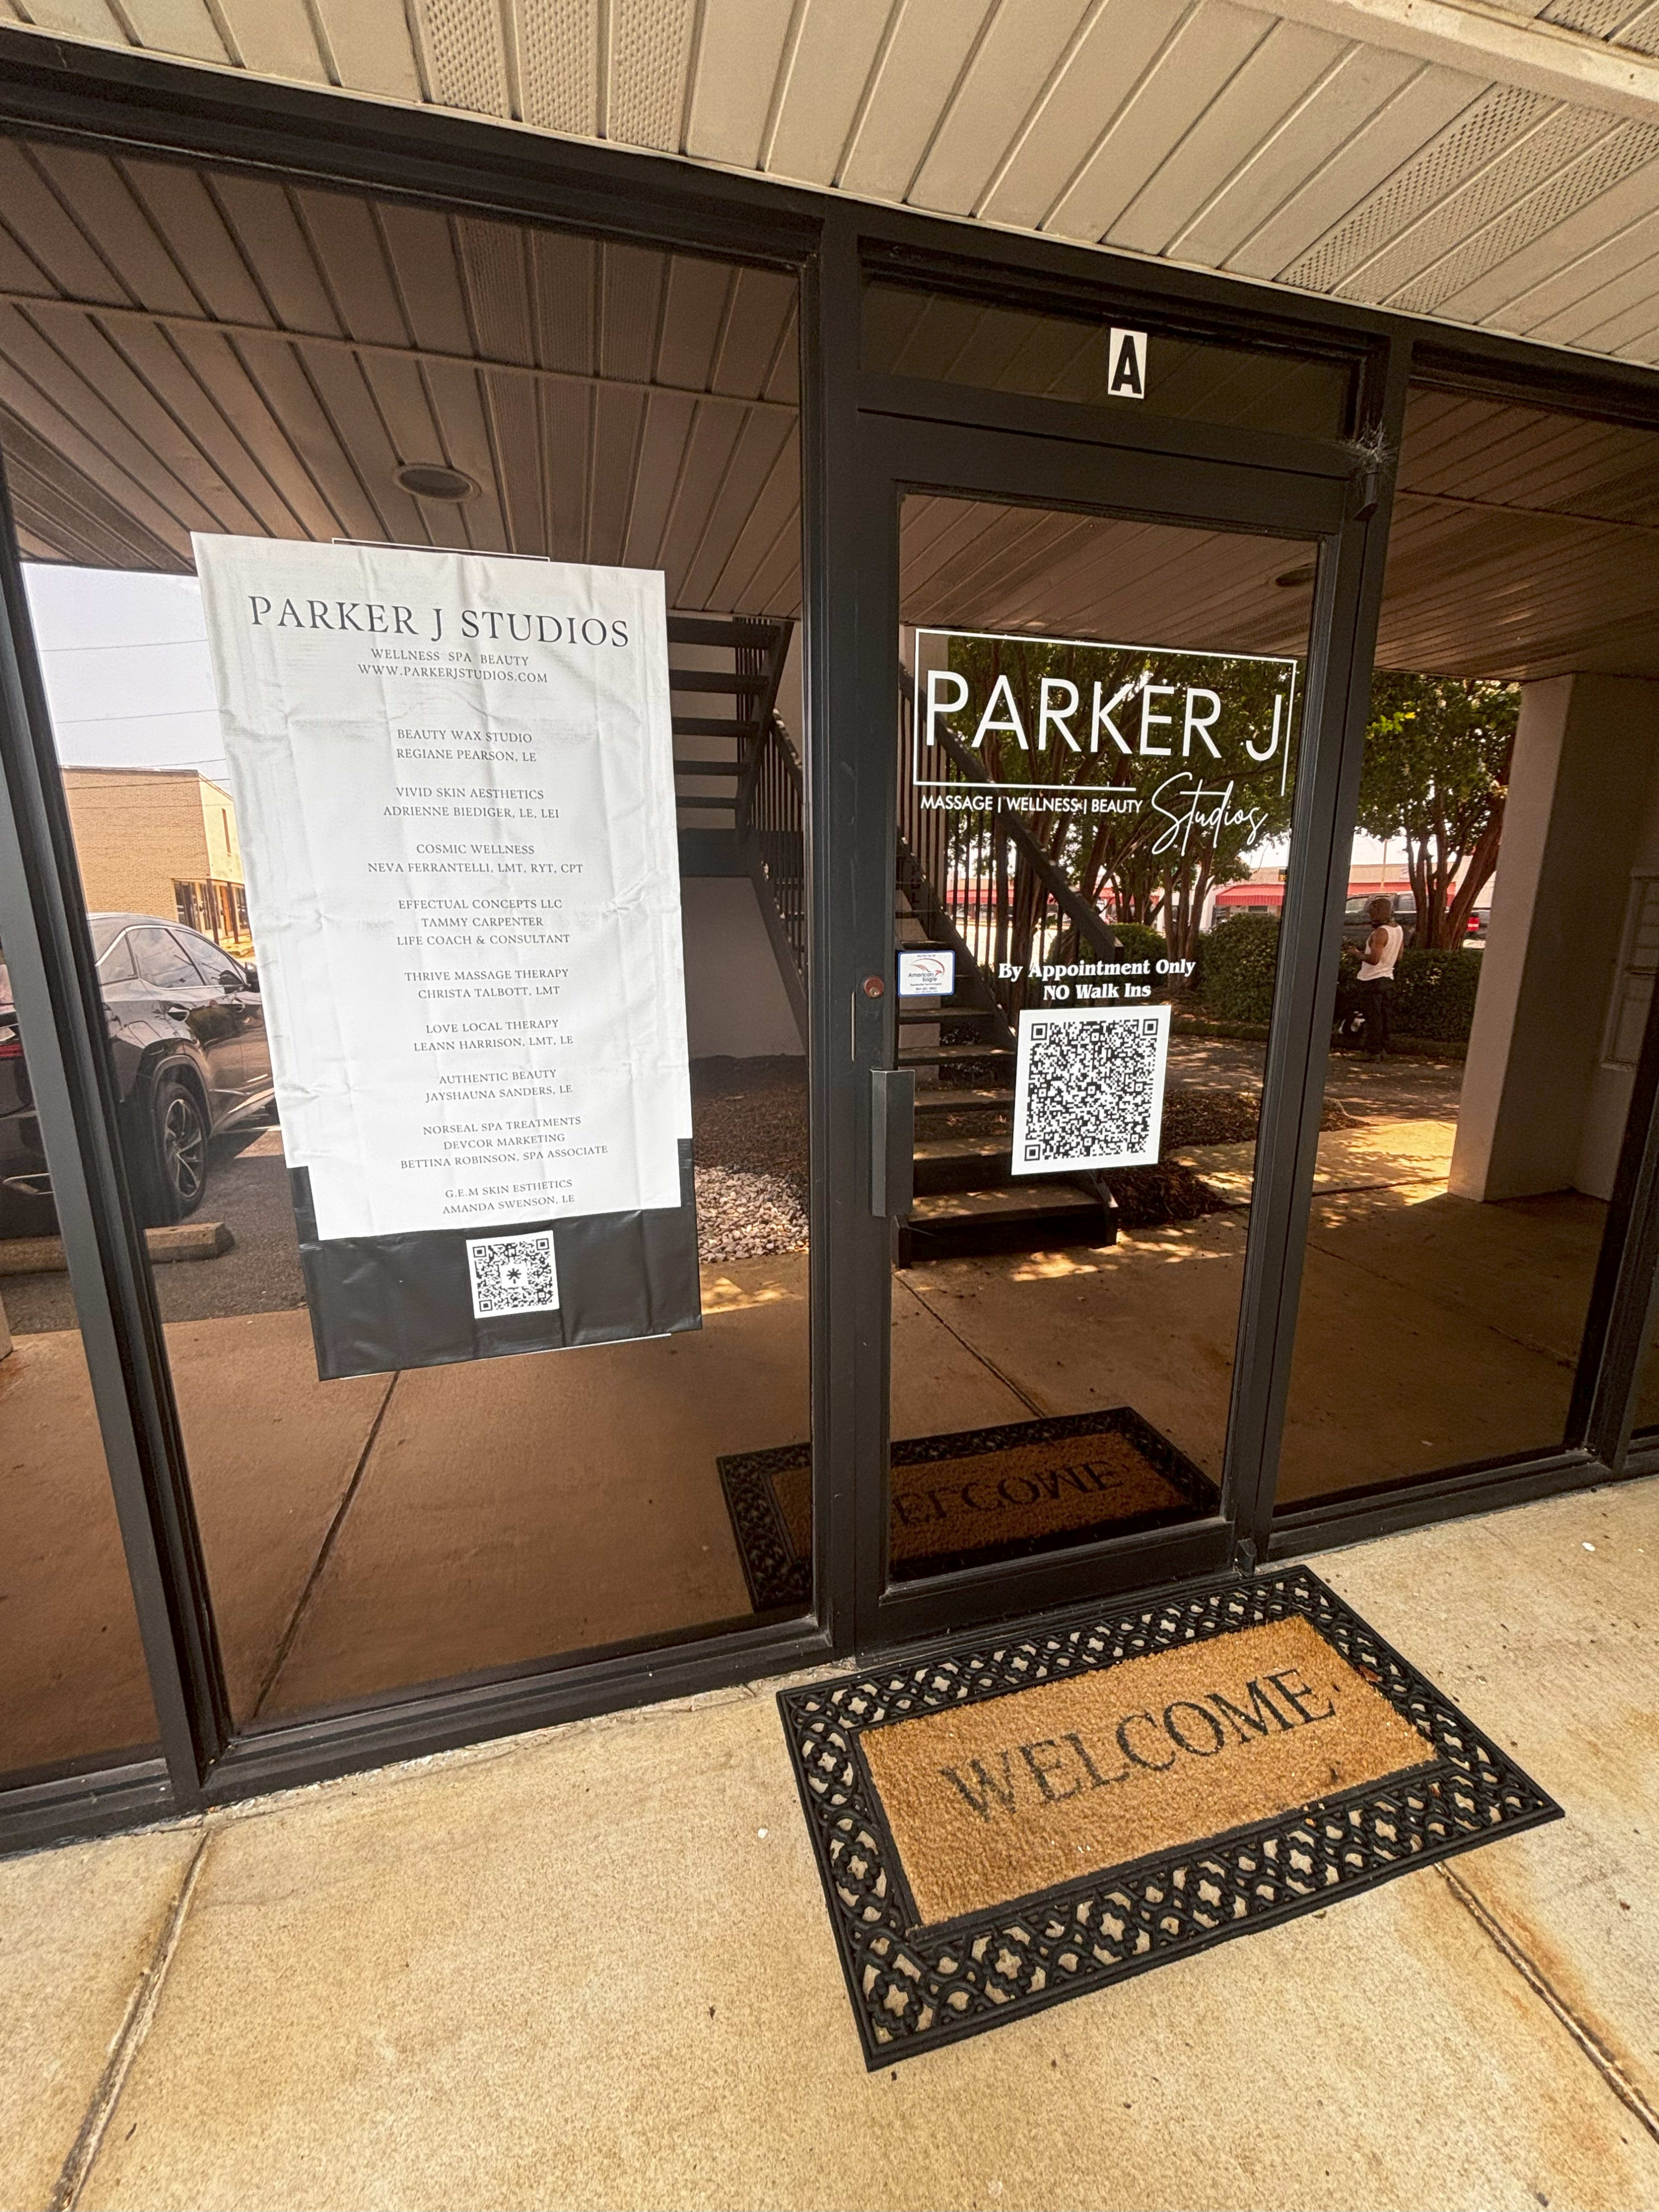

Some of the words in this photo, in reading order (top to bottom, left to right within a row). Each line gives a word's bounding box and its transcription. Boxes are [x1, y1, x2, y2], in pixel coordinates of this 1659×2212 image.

[1111, 334, 1142, 394] A
[248, 595, 419, 635] PARKER
[431, 607, 445, 642] J
[461, 609, 630, 648] STUDIOS
[371, 648, 439, 661] WELLNESS
[448, 652, 472, 662] SPA
[480, 655, 528, 666] BEAUTY
[358, 664, 547, 683] WWW.PARKERJSTUDIOS.COM
[926, 670, 1222, 759] PARKER
[1246, 694, 1283, 761] J
[397, 729, 446, 739] BEAUTY
[451, 731, 481, 741] WAX
[486, 732, 532, 743] STUDIO
[397, 749, 453, 759] REGIANE
[457, 750, 518, 762] PEARSON,
[522, 752, 536, 762] LE
[396, 788, 432, 797] VIVID
[437, 788, 465, 797] SKIN
[470, 789, 543, 799] AESTHETICS
[920, 795, 993, 811] MASSAGE
[1006, 797, 1077, 812] WELLNESS
[1092, 799, 1143, 813] BEAUTY
[384, 807, 449, 816] ADRIENNE
[454, 807, 515, 818] BIEDIGER,
[520, 809, 536, 819] LE,
[541, 809, 559, 818] LEI
[1151, 771, 1268, 857] Studios
[417, 844, 466, 854] COSMIC
[470, 845, 534, 854] WELLNESS
[368, 863, 404, 872] NEVA
[408, 863, 493, 873] FERRANTELLI,
[498, 864, 526, 873] LMT,
[531, 864, 556, 874] RYT,
[561, 864, 583, 873] CPT
[398, 900, 468, 909] EFFECTUAL
[472, 899, 537, 909] CONCEPTS
[541, 899, 562, 908] LLC
[421, 918, 467, 927] TAMMY
[473, 917, 543, 926] CARPENTER
[397, 937, 423, 945] LIFE
[427, 936, 471, 945] COACH
[477, 936, 485, 944] &
[490, 934, 570, 944] CONSULTANT
[404, 972, 450, 981] THRIVE
[455, 971, 512, 980] MASSAGE
[515, 969, 568, 978] THERAPY
[998, 963, 1023, 982] By
[1028, 960, 1150, 982] Appointment
[1156, 959, 1196, 976] Only
[418, 989, 471, 998] CHRISTA
[474, 987, 531, 997] TALBOTT,
[536, 986, 559, 995] LMT
[1043, 985, 1069, 1000] NO
[1076, 984, 1119, 999] Walk
[1124, 983, 1151, 997] Ins
[426, 1024, 458, 1033] LOVE
[463, 1022, 502, 1032] LOCAL
[505, 1020, 558, 1030] THERAPY
[414, 1042, 454, 1051] LEANN
[460, 1038, 524, 1049] HARRISON,
[530, 1037, 556, 1045] LMT,
[560, 1036, 573, 1044] LE
[439, 1073, 508, 1084] AUTHENTIC
[512, 1069, 556, 1080] BEAUTY
[426, 1090, 495, 1103] JAYSHAUNA
[500, 1086, 555, 1097] SANDERS,
[560, 1085, 572, 1093] LE
[423, 1124, 478, 1135] NORSEAL
[482, 1123, 502, 1131] SPA
[505, 1116, 581, 1129] TREATMENTS
[444, 1139, 493, 1150] DEVCOR
[497, 1134, 565, 1146] MARKETING
[401, 1158, 451, 1169] BETTINA
[455, 1154, 519, 1165] ROBINSON,
[523, 1151, 543, 1160] SPA
[547, 1146, 607, 1158] ASSOCIATE
[445, 1188, 478, 1198] G.E.M
[483, 1185, 509, 1195] SKIN
[513, 1179, 572, 1192] ESTHETICS
[443, 1203, 494, 1214] AMANDA
[499, 1196, 558, 1209] SWENSON,
[563, 1195, 575, 1203] LE
[938, 1669, 1337, 1823] WELCOME
